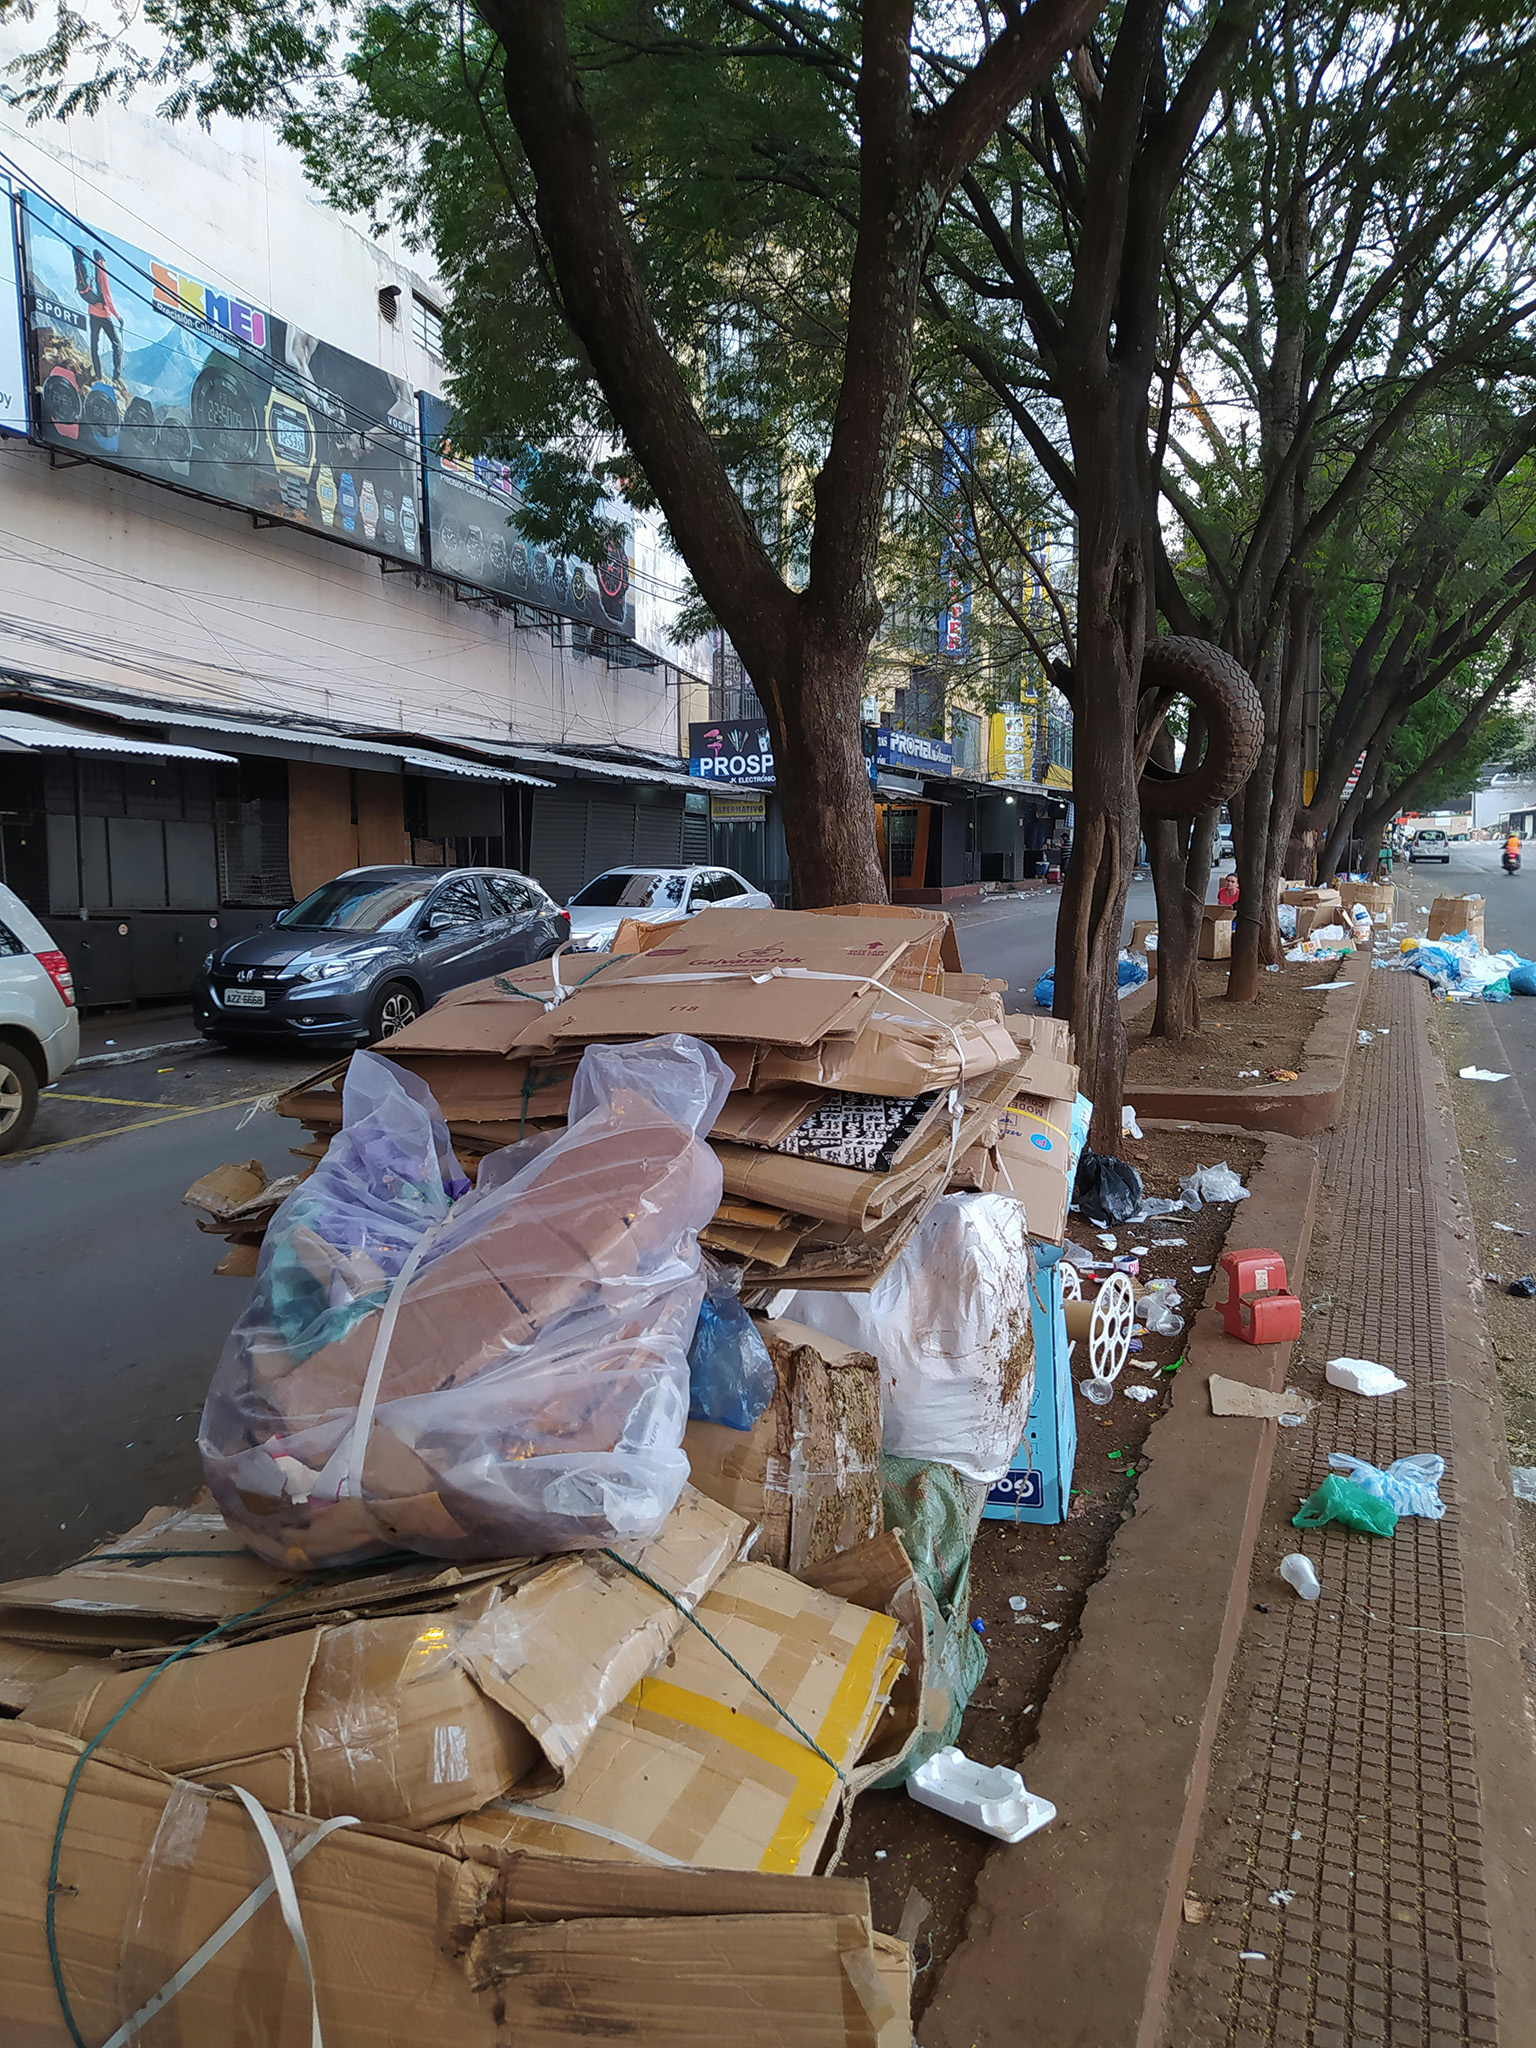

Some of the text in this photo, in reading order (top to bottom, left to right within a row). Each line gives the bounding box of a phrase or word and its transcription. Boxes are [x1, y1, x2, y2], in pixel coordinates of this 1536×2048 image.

[35, 298, 79, 326] SPORT
[149, 260, 265, 349] SKMEI
[387, 416, 413, 434] VOGUE
[714, 805, 764, 813] ALTERNATIVO
[688, 957, 806, 966] Galvanotek
[1015, 1095, 1045, 1107] COLO
